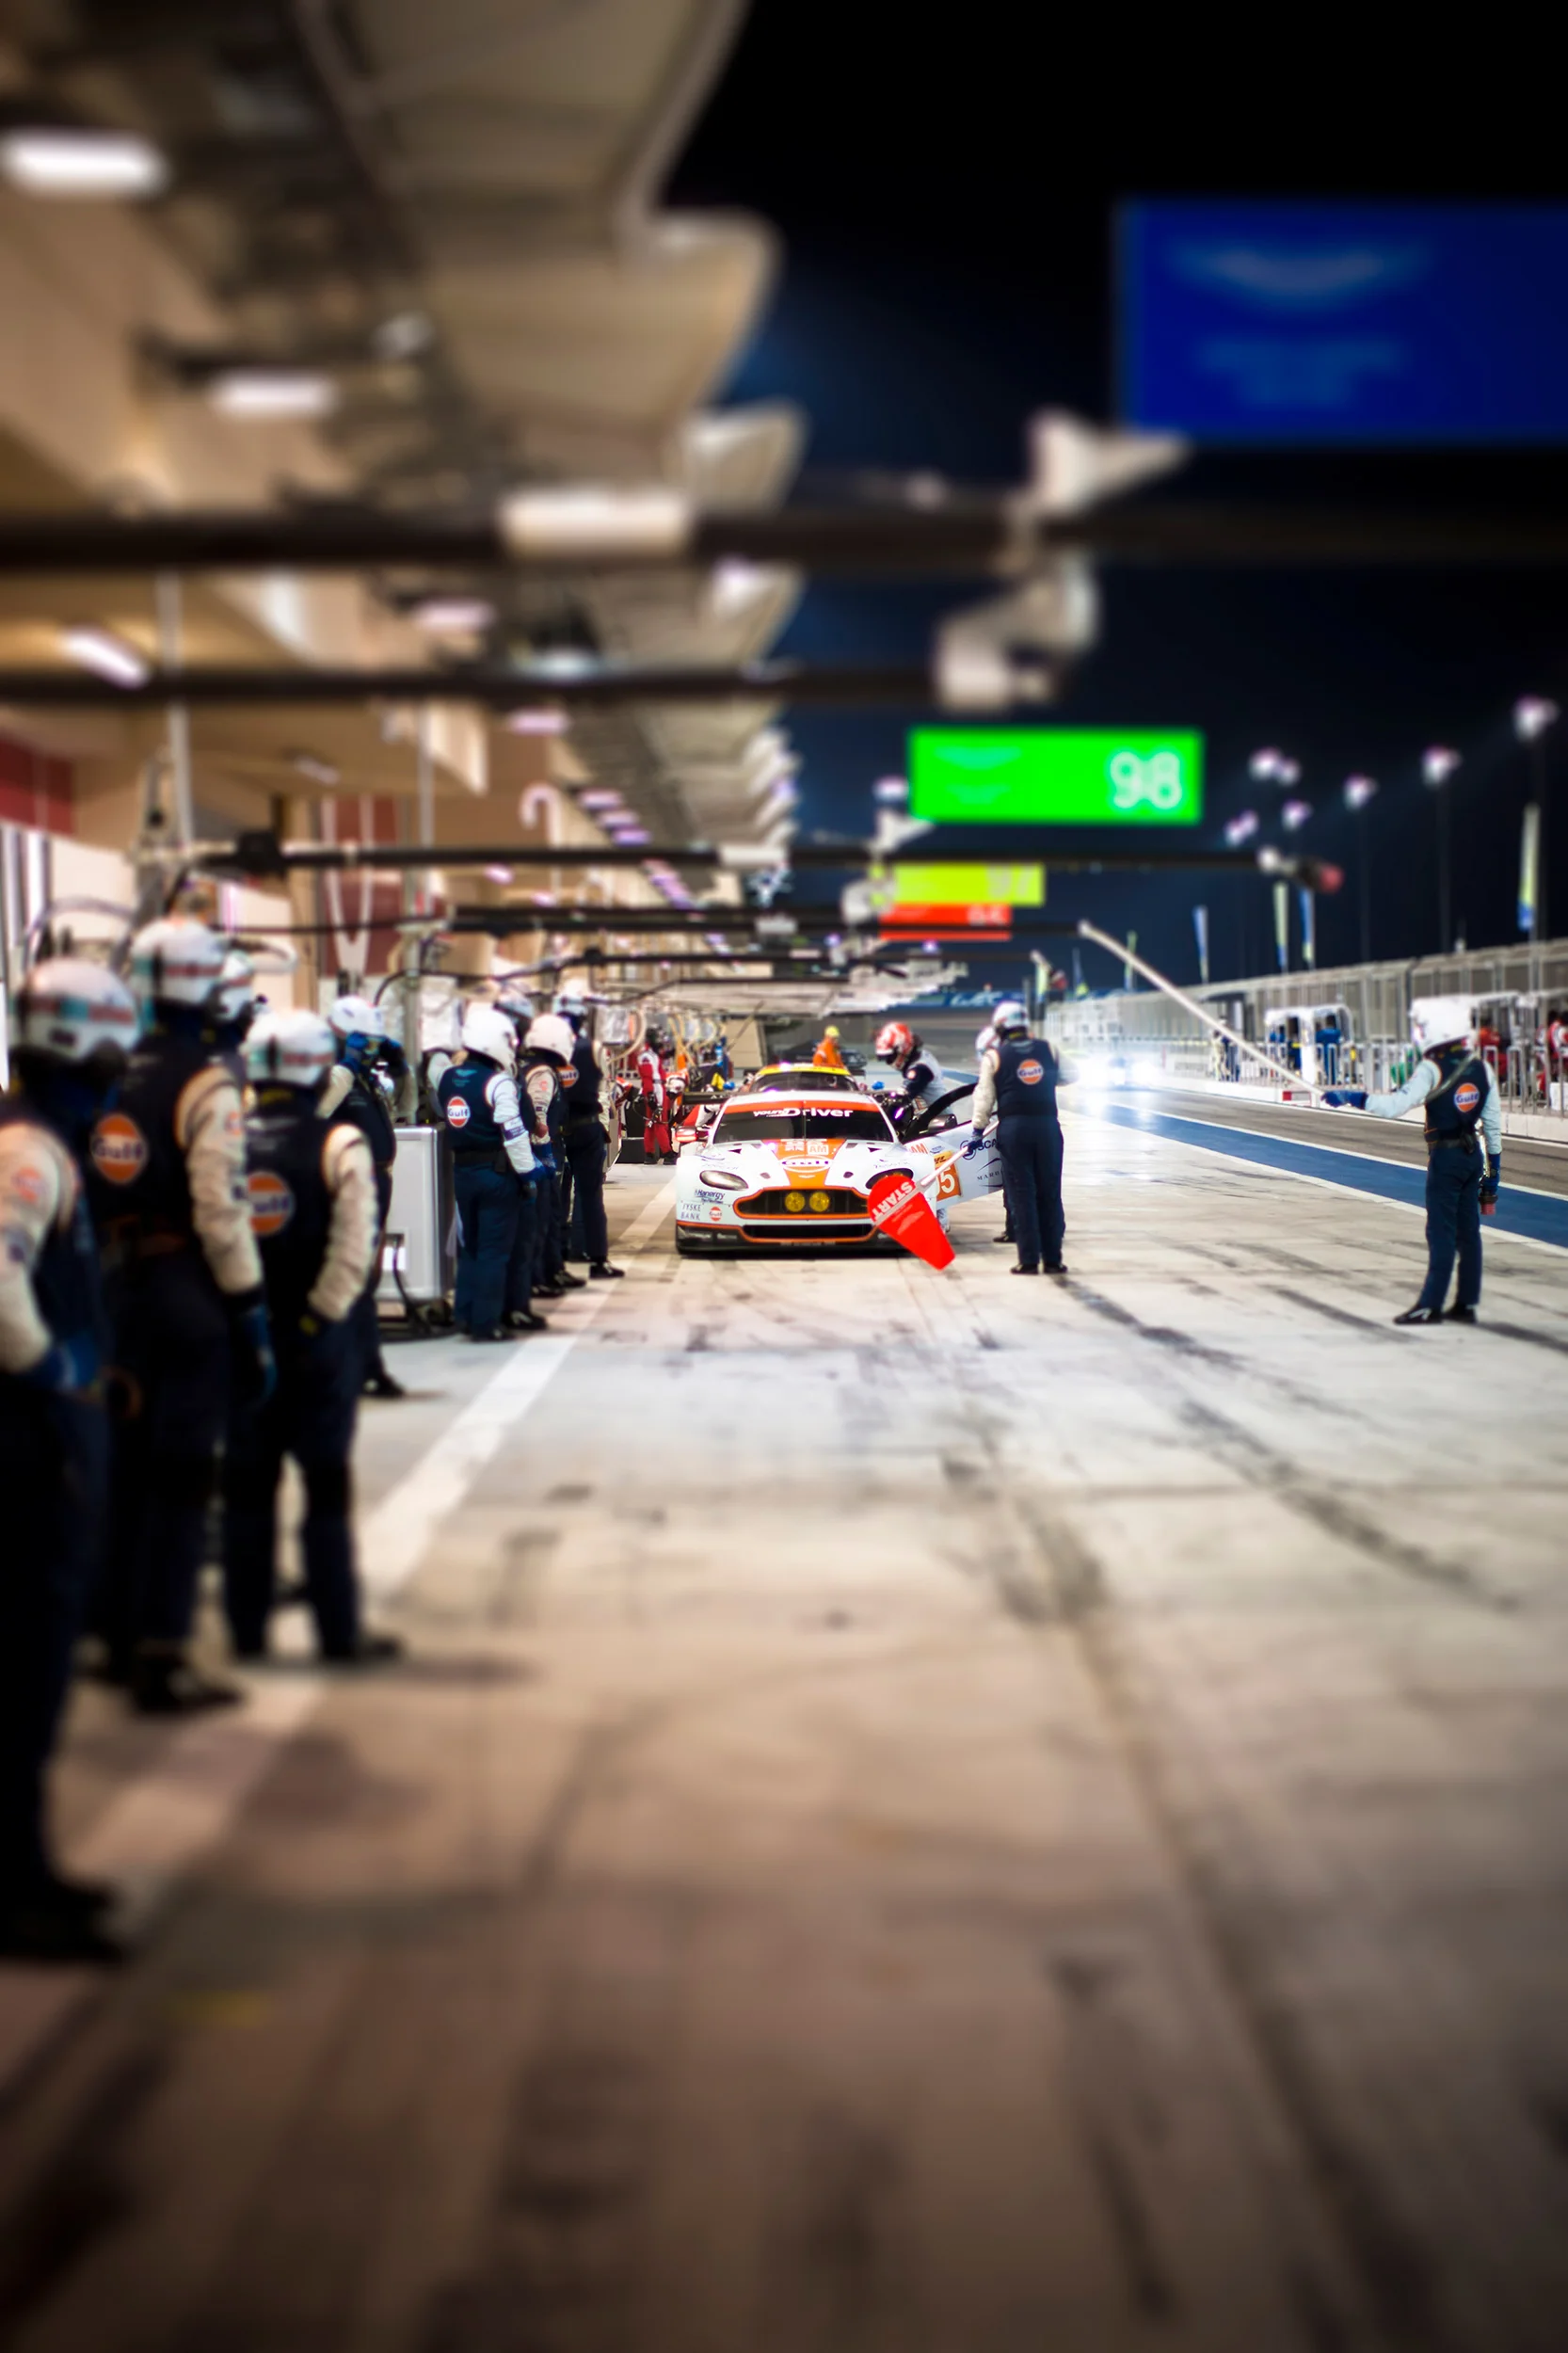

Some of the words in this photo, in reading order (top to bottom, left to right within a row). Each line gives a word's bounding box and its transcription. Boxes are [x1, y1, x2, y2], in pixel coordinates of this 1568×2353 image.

[1110, 751, 1182, 808] 98
[1018, 1067, 1043, 1078] Gulf
[1456, 1092, 1479, 1103] Gulf
[447, 1108, 469, 1117] Gulf
[94, 1136, 143, 1159] Gulf
[808, 1144, 827, 1153] AM
[697, 1190, 726, 1201] Hanergy
[872, 1180, 914, 1221] START
[680, 1211, 701, 1222] BANK
